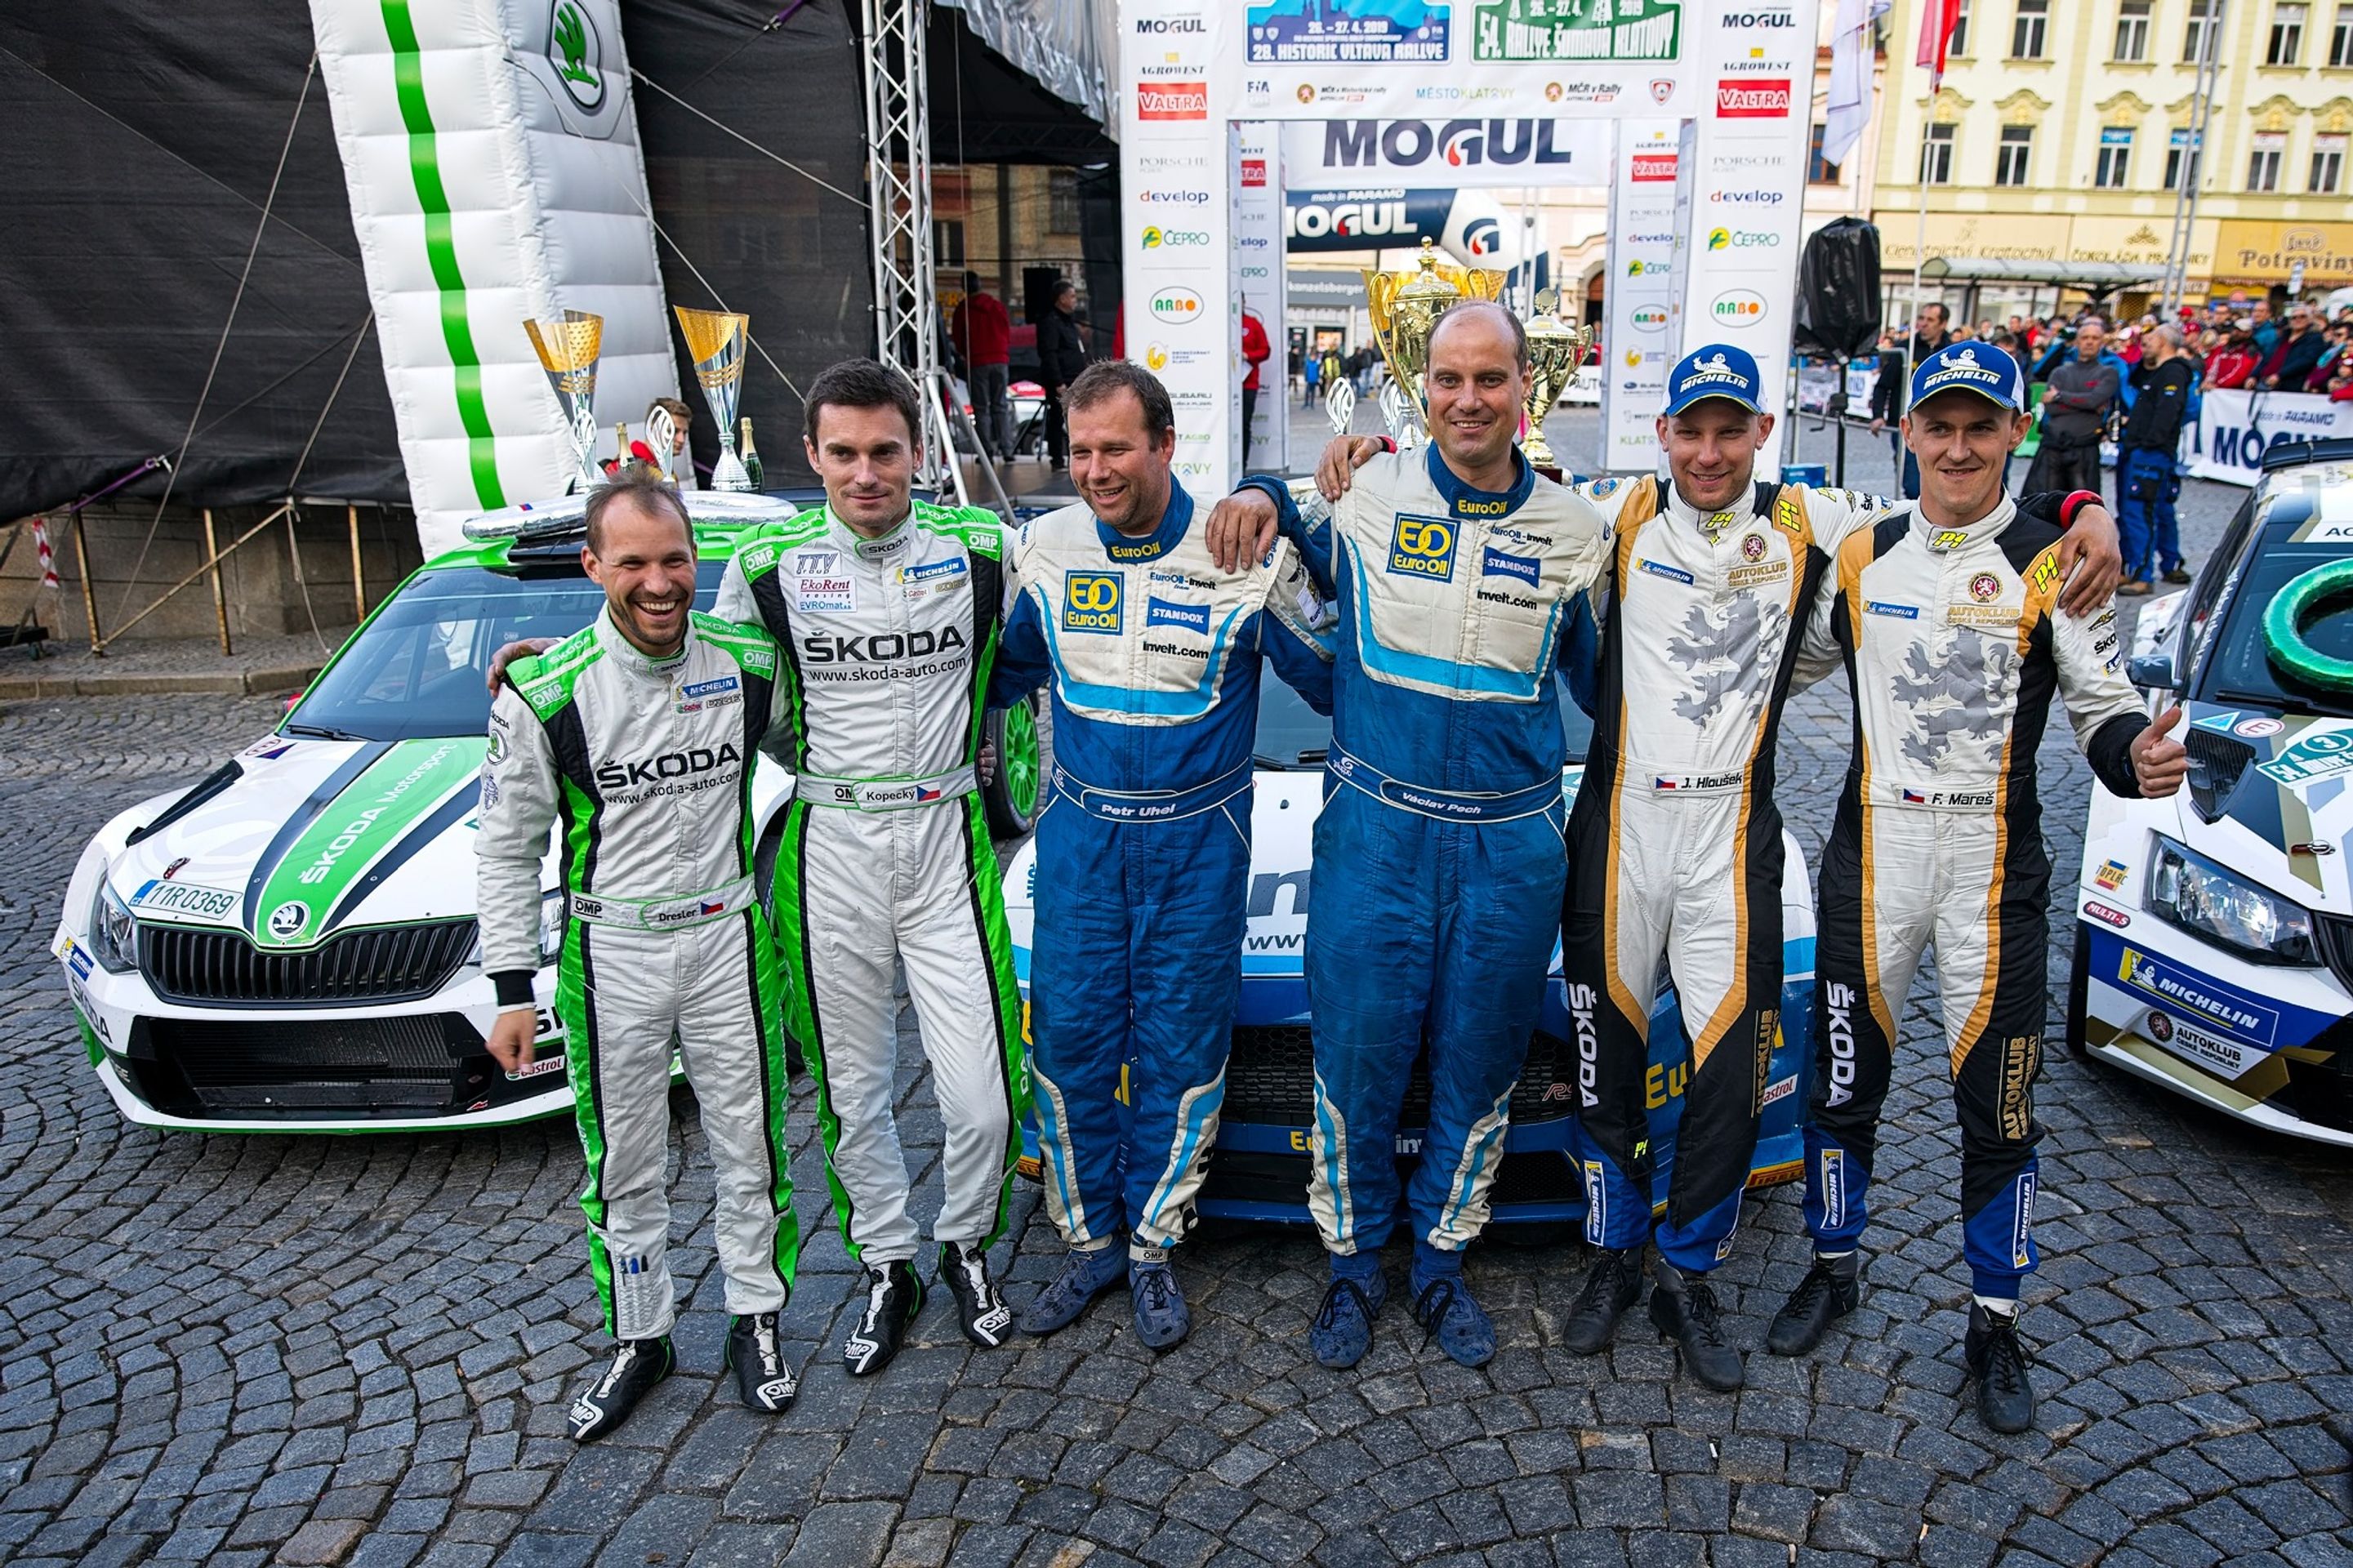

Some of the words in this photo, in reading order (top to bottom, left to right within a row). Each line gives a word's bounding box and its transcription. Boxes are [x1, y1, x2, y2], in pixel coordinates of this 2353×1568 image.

[1137, 20, 1207, 33] MOGUL
[1722, 14, 1796, 28] MOGUL
[1505, 20, 1551, 58] RALLYE
[1277, 43, 1337, 60] HISTORIC
[1393, 42, 1444, 60] RALLYE
[1140, 93, 1206, 111] VALTRA
[1718, 90, 1789, 109] VALTRA
[1323, 119, 1571, 167] MOGUL
[1140, 190, 1209, 203] develop
[1710, 190, 1783, 204] develop
[1164, 230, 1210, 246] ČEPRO
[1629, 234, 1673, 242] develo
[1732, 231, 1780, 247] ČEPRO
[1241, 268, 1268, 278] EPRO
[1644, 263, 1672, 274] ČEPR
[1155, 300, 1196, 311] ARBO
[1717, 302, 1759, 314] ARBO
[1680, 373, 1748, 393] MICHELIN
[1923, 369, 2001, 390] MICHELIN
[1457, 499, 1508, 514] EuroOil
[968, 534, 998, 549] OMP
[1111, 541, 1161, 559] EuroOil
[745, 548, 774, 572] OMP
[797, 553, 839, 570] TTV
[1487, 557, 1535, 577] STANDOX
[916, 561, 960, 578] MICHELIN
[1652, 566, 1691, 581] MICHELIN
[1728, 561, 1787, 580] AUTOKLUB
[800, 578, 850, 590] EkoRent
[1152, 608, 1205, 624] STANDOX
[1878, 607, 1914, 617] MICHELIN
[1948, 605, 2021, 618] AUTOKLUB
[804, 626, 966, 662] ŠKODA
[2094, 632, 2116, 654] ŠKO
[743, 652, 773, 667] OMP
[809, 656, 966, 682] www.skoda-auto.com
[532, 682, 565, 706] OMP
[689, 679, 733, 695] MICHELIN
[2313, 736, 2340, 750] 3
[381, 744, 459, 803] Motorsport
[596, 742, 742, 791] ŠKODA
[605, 769, 742, 806] www.skoda-auto.com
[1681, 777, 1694, 788] J.
[1696, 772, 1743, 788] Hloušek
[835, 787, 854, 800] OM
[867, 788, 916, 803] Kopecký
[1402, 791, 1444, 812] Václav
[1446, 800, 1482, 815] Pech
[1932, 793, 1945, 805] F.
[1947, 789, 1994, 806] Mareš
[1101, 804, 1133, 817] Petr
[1139, 804, 1177, 817] Uhel
[297, 805, 382, 885] ŠKODA
[2095, 865, 2128, 887] TOPLAC
[574, 900, 603, 916] OMP
[658, 907, 697, 923] Dresler
[2158, 978, 2260, 1030] MICHELIN
[1568, 982, 1598, 1108] ŠKODA
[1826, 980, 1856, 1108] ŠKODA
[2176, 1027, 2242, 1062] AUTOKLUB
[521, 1057, 562, 1077] astrol
[2200, 1047, 2240, 1071] REPUBLIKY
[1763, 1078, 1794, 1102] astrol
[2003, 1036, 2026, 1140] AUTOKLUB
[1828, 1170, 1841, 1227] MICHELIN
[2020, 1181, 2031, 1244] MICHELIN
[1143, 1251, 1164, 1260] OMP
